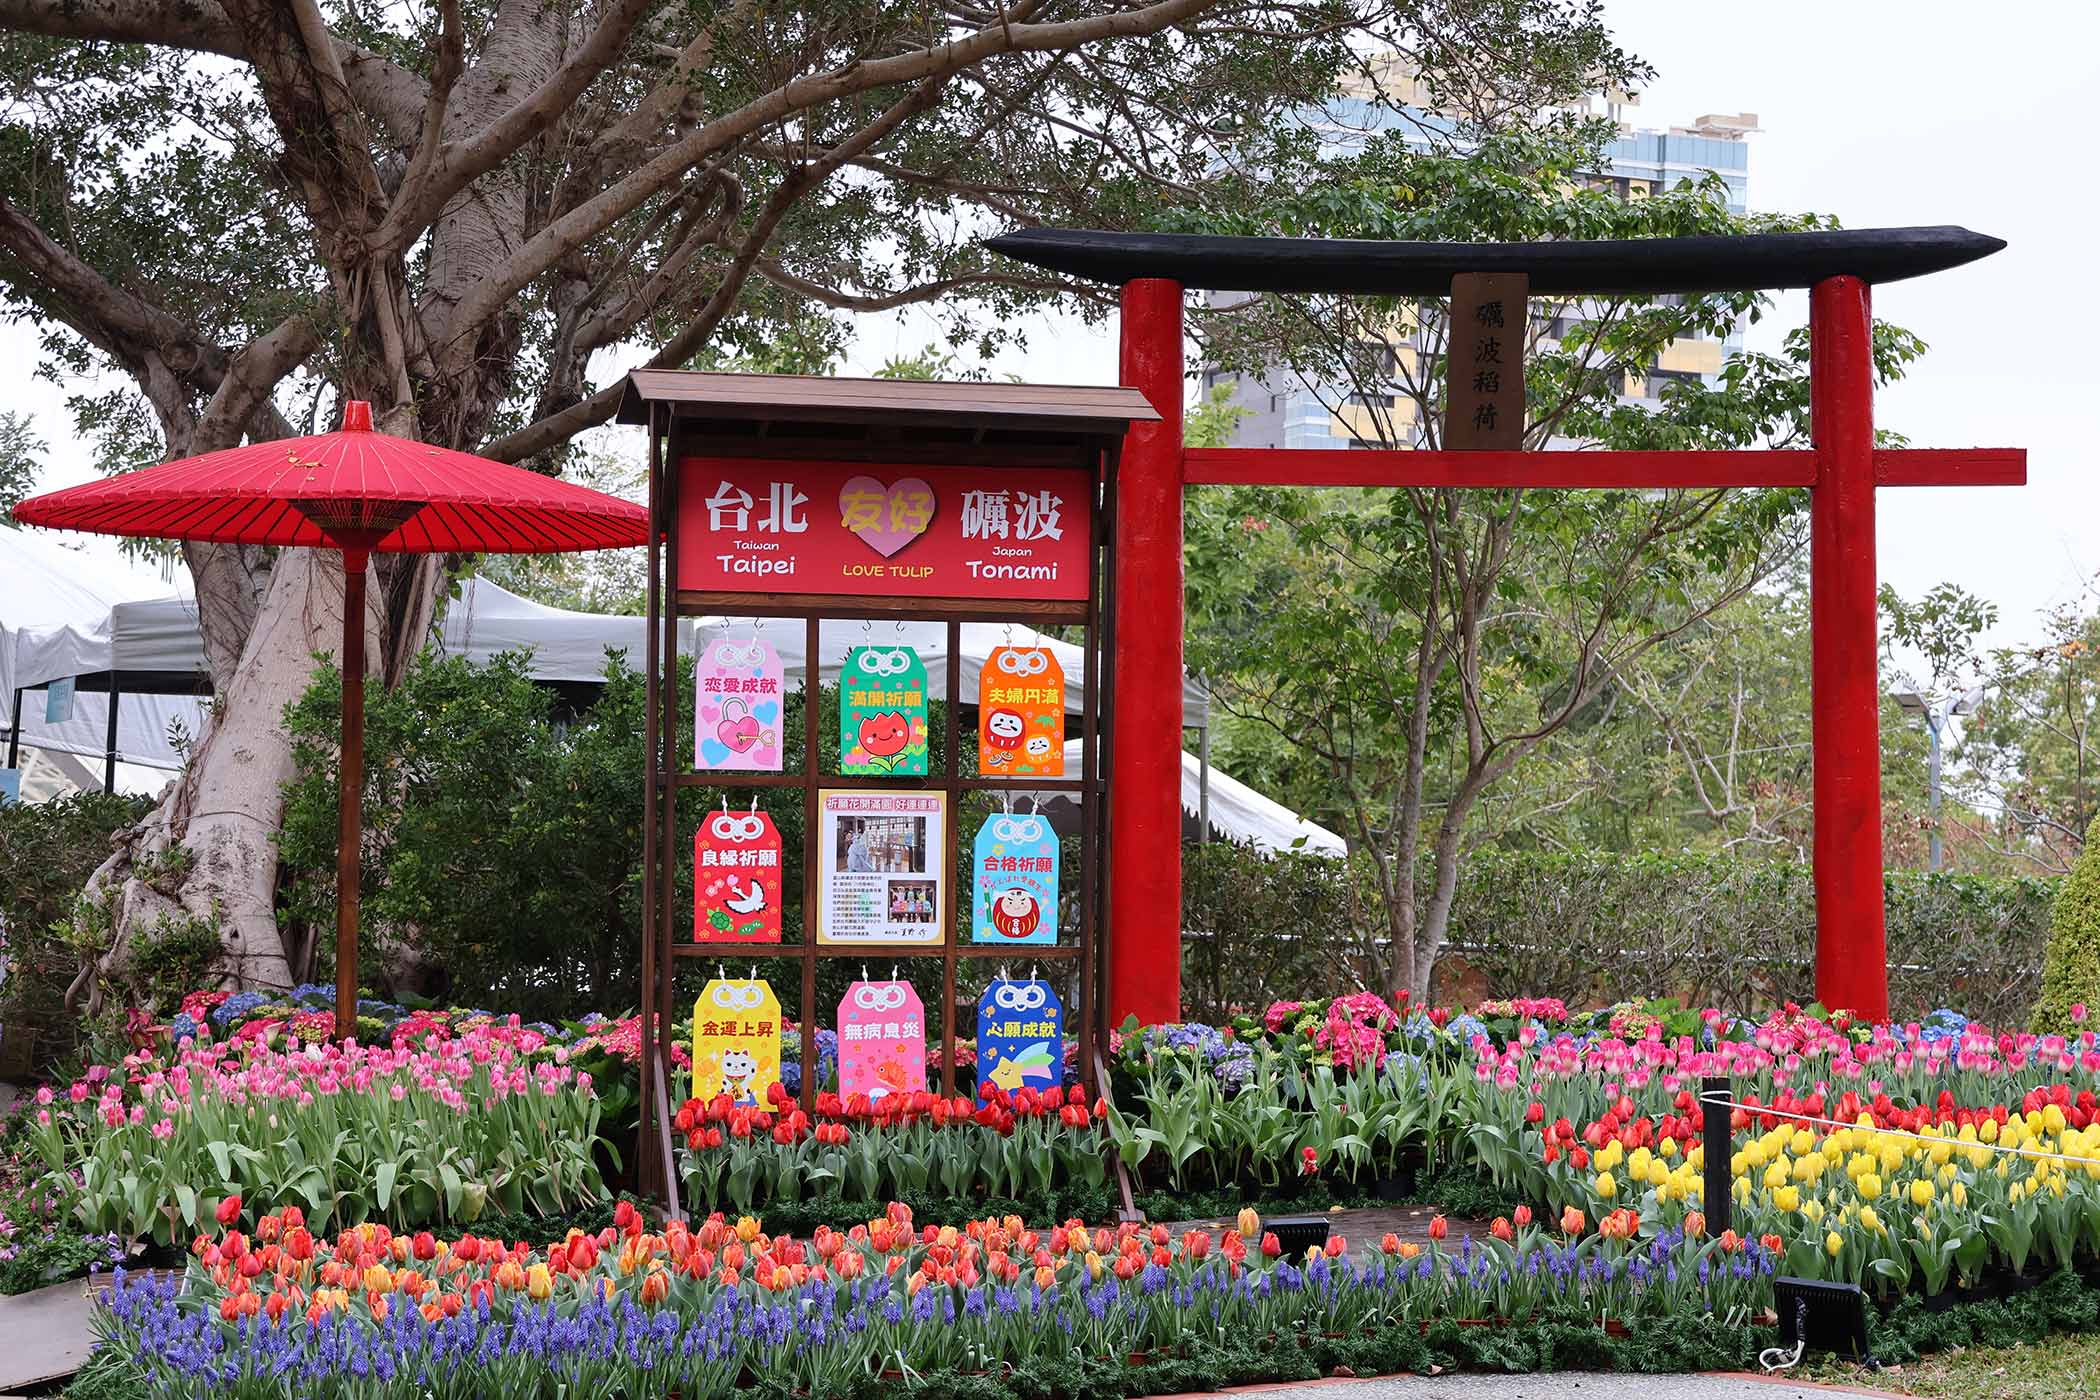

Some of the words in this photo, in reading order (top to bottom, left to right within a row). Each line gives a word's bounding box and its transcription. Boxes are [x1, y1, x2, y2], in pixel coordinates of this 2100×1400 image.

[705, 480, 809, 533] 台北
[840, 489, 931, 535] 友好
[960, 489, 1064, 541] 礪波
[733, 540, 780, 551] Taiwan
[992, 546, 1032, 557] Japan
[716, 554, 796, 577] Taipei
[842, 564, 885, 577] LOVE
[888, 565, 934, 578] TULIP
[965, 560, 1058, 580] Tonami
[704, 677, 777, 694] 恋愛成就
[988, 687, 1060, 705] 夫婦円満
[702, 849, 778, 867] 良縁祈願
[983, 855, 1053, 872] 合格祈願
[702, 1020, 774, 1038] 金運上昇
[844, 1021, 921, 1041] 無病息災
[986, 1021, 1057, 1038] 心願成就
